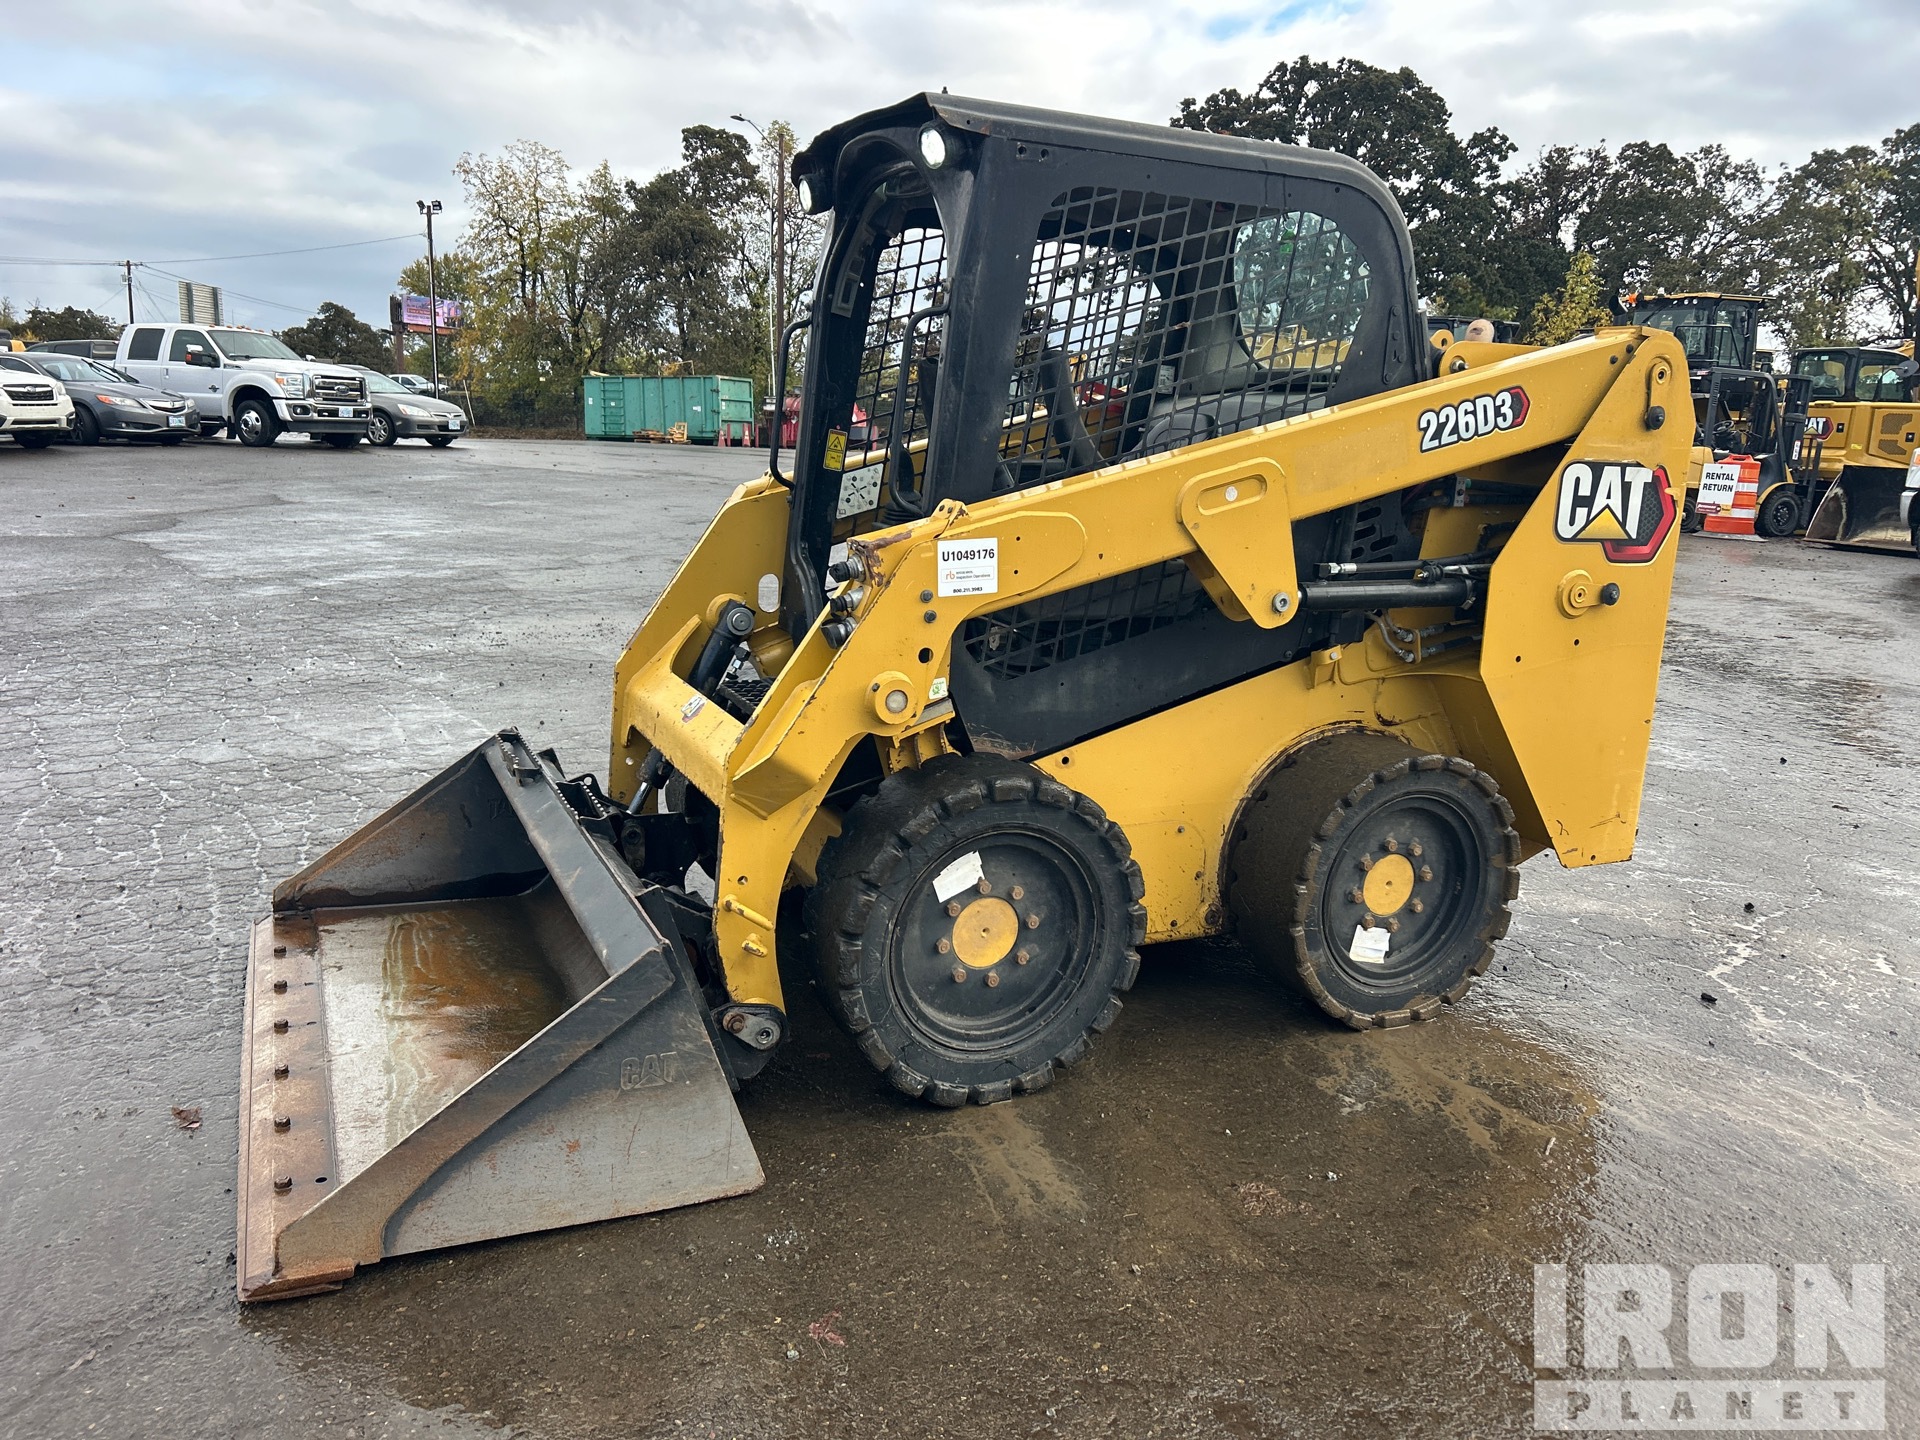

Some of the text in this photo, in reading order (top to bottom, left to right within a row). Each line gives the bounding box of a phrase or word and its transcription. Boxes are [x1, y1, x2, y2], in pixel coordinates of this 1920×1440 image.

[1419, 391, 1513, 451] 226D3
[1702, 483, 1734, 493] RETURN
[1705, 472, 1735, 481] RENTAL
[1556, 463, 1653, 540] CAT
[942, 548, 995, 562] U1049176
[621, 1051, 679, 1091] CAT
